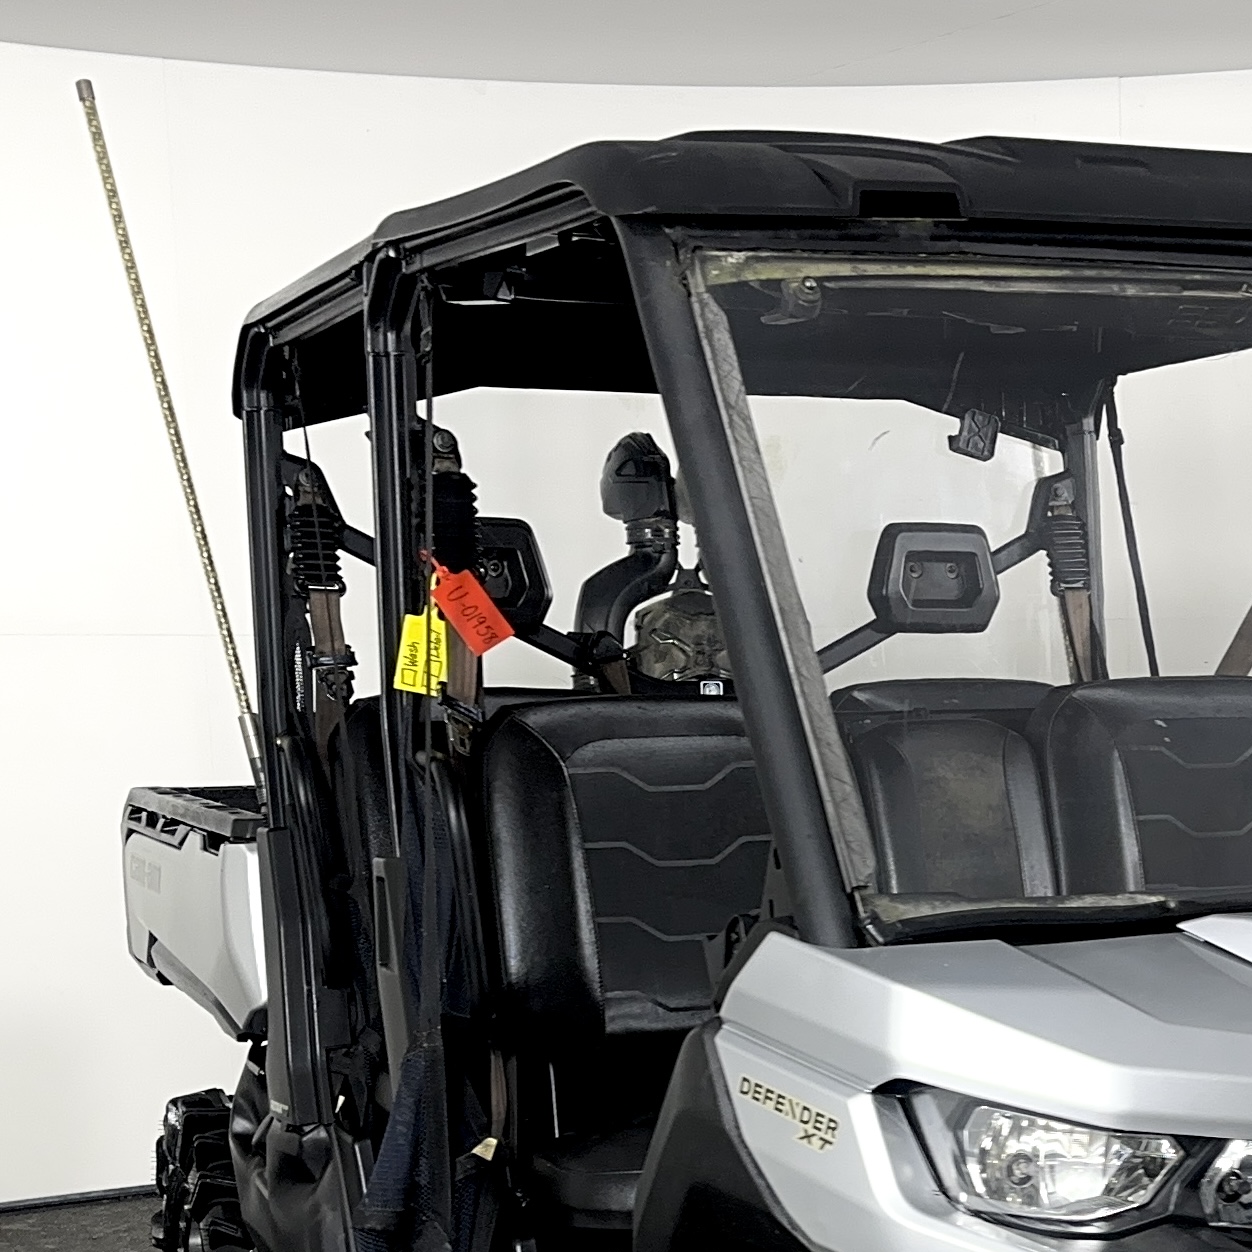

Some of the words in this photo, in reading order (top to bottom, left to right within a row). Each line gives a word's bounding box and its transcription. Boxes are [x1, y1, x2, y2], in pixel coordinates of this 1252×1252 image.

[447, 585, 499, 644] U-01958
[404, 641, 420, 671] Wash
[740, 1076, 839, 1138] DEFENDER
[797, 1128, 833, 1150] XT
